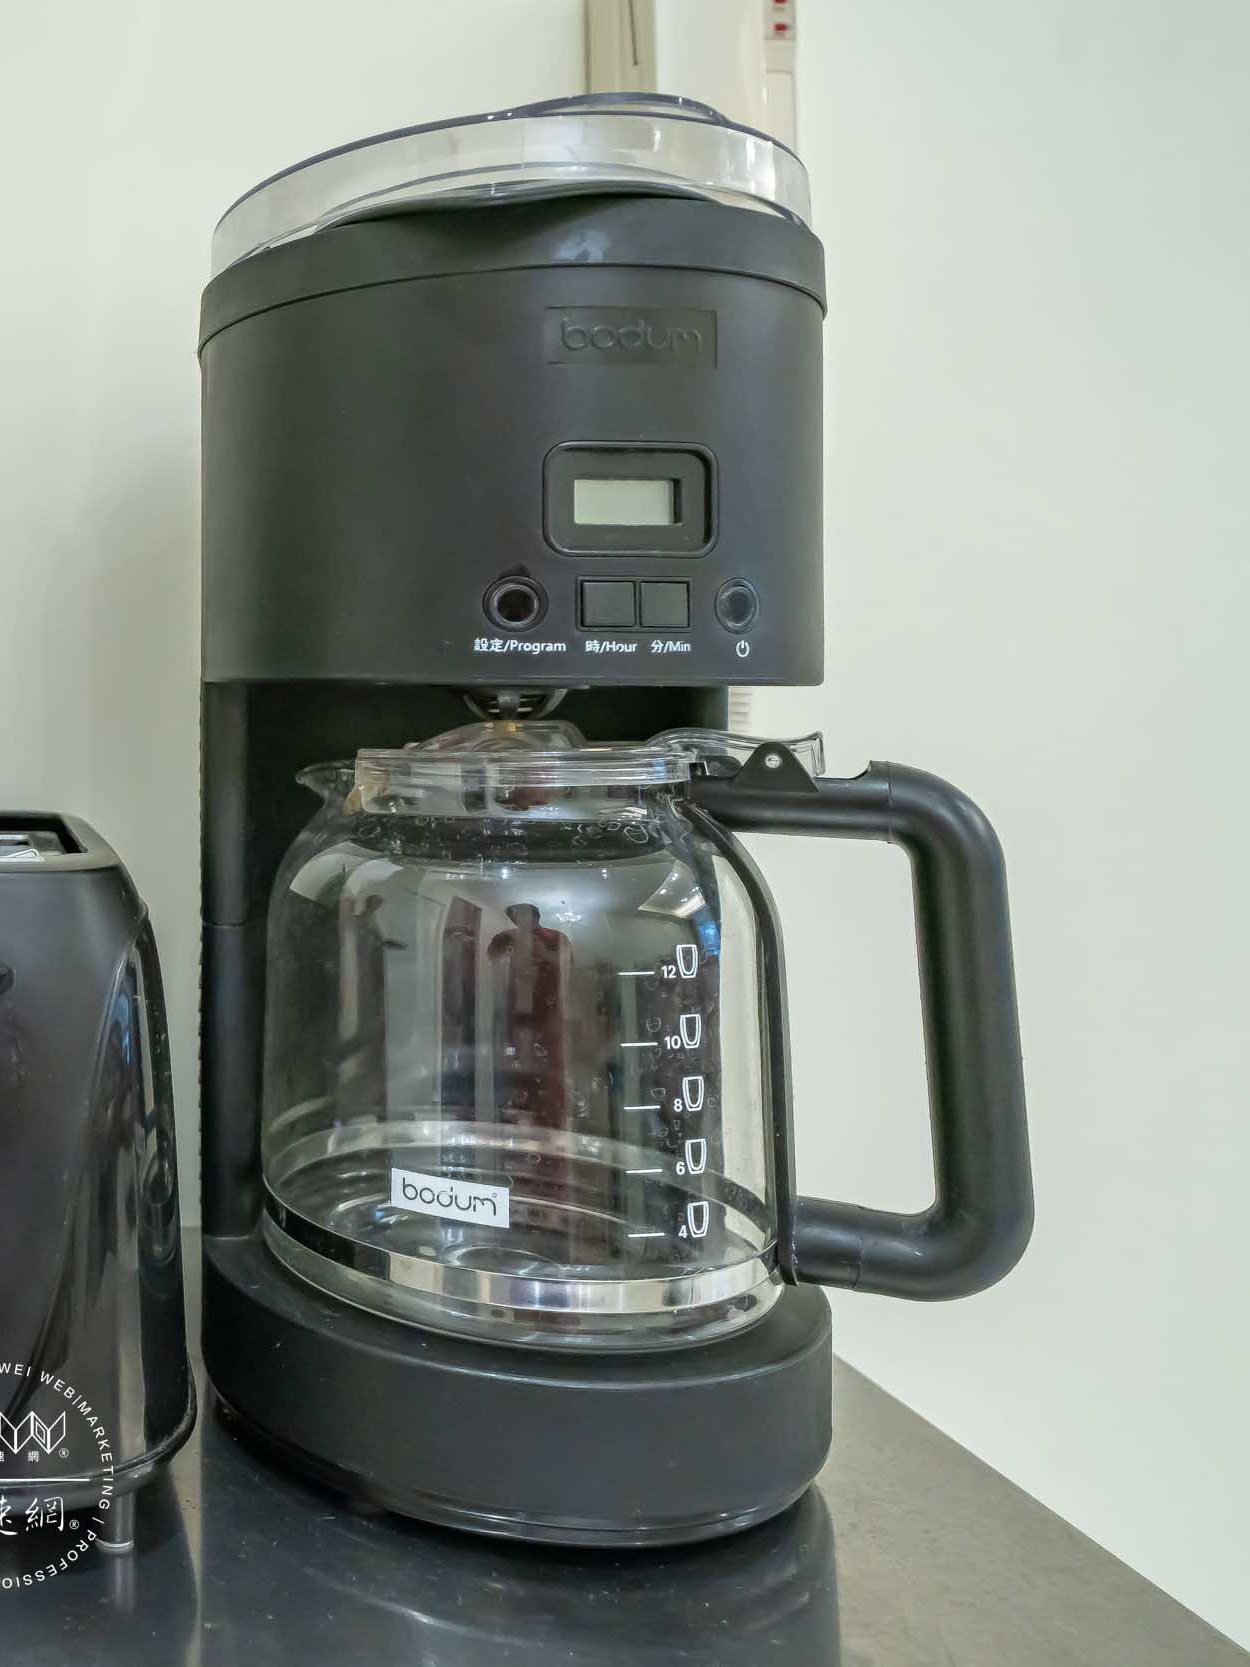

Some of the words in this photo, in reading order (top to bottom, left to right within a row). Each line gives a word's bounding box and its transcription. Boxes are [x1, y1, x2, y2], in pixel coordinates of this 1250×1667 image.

[561, 317, 702, 352] bodum
[474, 638, 567, 655] 設定/Program
[585, 640, 638, 653] 時/Hour
[651, 639, 691, 653] 分/Min
[661, 966, 676, 978] 12
[664, 1036, 680, 1049] 10
[673, 1099, 682, 1112] 8
[676, 1162, 685, 1175] 6
[402, 1177, 496, 1216] bodum
[678, 1225, 688, 1238] 4
